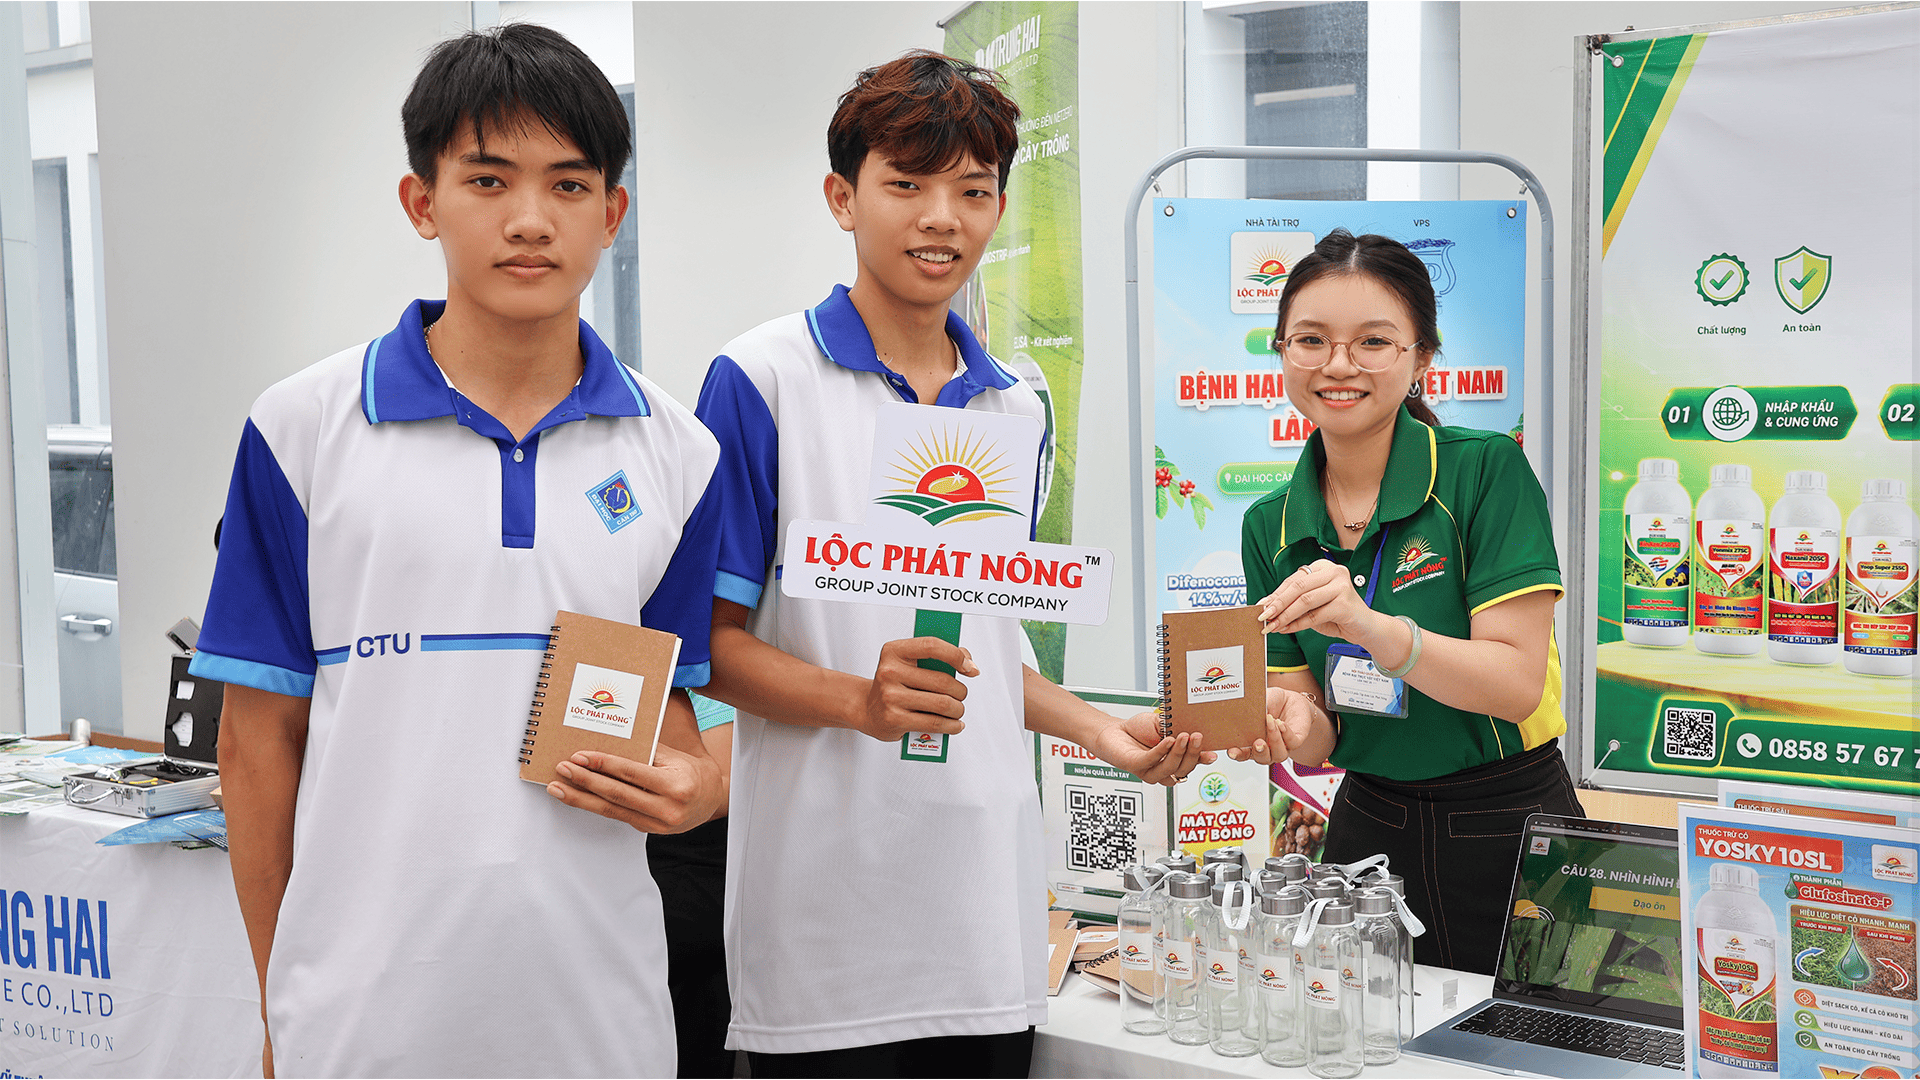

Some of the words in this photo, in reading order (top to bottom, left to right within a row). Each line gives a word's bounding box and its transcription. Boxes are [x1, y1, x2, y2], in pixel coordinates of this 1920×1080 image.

[1022, 14, 1040, 54] HAI
[1020, 140, 1039, 164] CÂY
[1040, 129, 1070, 158] TRỒNG
[1245, 216, 1264, 226] NHÀ
[1266, 216, 1280, 226] TÀI
[1282, 218, 1300, 228] TRỢ
[1413, 219, 1430, 227] VPS
[1237, 287, 1254, 298] LỘC
[1256, 287, 1280, 298] PHÁT
[1697, 324, 1718, 335] Chất
[1720, 325, 1746, 336] lượng
[1782, 324, 1796, 332] An
[1798, 322, 1822, 332] toàn
[1034, 336, 1042, 347] Kit
[1180, 370, 1237, 405] BỆNH
[1458, 370, 1503, 394] NAM
[1668, 406, 1691, 424] 01
[1764, 402, 1798, 416] NHẬP
[1800, 398, 1834, 413] KHẨU
[1887, 403, 1915, 422] 02
[1764, 418, 1773, 428] &
[1776, 416, 1810, 428] CUNG
[1812, 412, 1839, 428] ỨNG
[1234, 474, 1250, 485] ĐẠI
[1253, 472, 1273, 485] HỌC
[804, 532, 872, 572] LỘC
[882, 542, 972, 578] PHÁT
[979, 552, 1084, 590] NÔNG
[814, 576, 874, 594] GROUP
[876, 582, 928, 599] JOINT
[930, 587, 984, 604] STOCK
[987, 592, 1068, 612] COMPANY
[356, 632, 410, 659] CTU
[1191, 686, 1202, 694] LỘC
[1204, 684, 1220, 692] PHÁT
[1221, 682, 1240, 690] NÔNG
[570, 706, 585, 715] LỘC
[586, 709, 605, 719] PHÁT
[606, 714, 629, 724] NÔNG
[1768, 738, 1828, 762] 0858
[1835, 743, 1866, 765] 57
[1872, 746, 1904, 768] 67
[1074, 767, 1091, 776] NHẬN
[1092, 768, 1105, 776] QUÀ
[1105, 768, 1118, 778] LIỀN
[1119, 770, 1130, 778] TAY
[1180, 812, 1214, 828] MÁT
[1218, 810, 1247, 826] CÂY
[1180, 828, 1206, 842] MÁT
[1210, 826, 1254, 840] BÔNG
[1698, 827, 1722, 837] THUỐC
[1723, 830, 1738, 838] TRỪ
[1738, 831, 1749, 840] CỎ
[1699, 837, 1776, 863] YOSKY
[1778, 846, 1832, 871] 10SL
[1561, 864, 1588, 878] CÂU
[1589, 868, 1607, 880] 28.
[1609, 870, 1640, 885] NHÌN
[1642, 872, 1674, 888] HÌNH
[1800, 874, 1822, 884] THÀNH
[1632, 898, 1652, 910] Đạo
[1654, 901, 1666, 911] ôn
[1800, 886, 1894, 909] Glufosinate-P
[1799, 908, 1816, 918] HIỆU
[1816, 911, 1830, 919] LỰC
[1831, 912, 1846, 922] DIỆT
[1848, 914, 1858, 923] CỎ
[1888, 921, 1910, 931] MẠNH
[44, 894, 111, 980] HAI
[1718, 960, 1739, 971] Yosky
[21, 982, 113, 1017] CO.,LTD
[13, 1020, 114, 1052] SOLUTION
[1823, 1021, 1838, 1029] HIỆU
[1839, 1024, 1851, 1032] LỰC
[1852, 1026, 1873, 1035] NHANH
[1834, 1043, 1851, 1052] TOÀN
[1852, 1047, 1865, 1055] CHO
[1866, 1049, 1879, 1057] CÂY
[1880, 1052, 1901, 1062] TRỒNG
